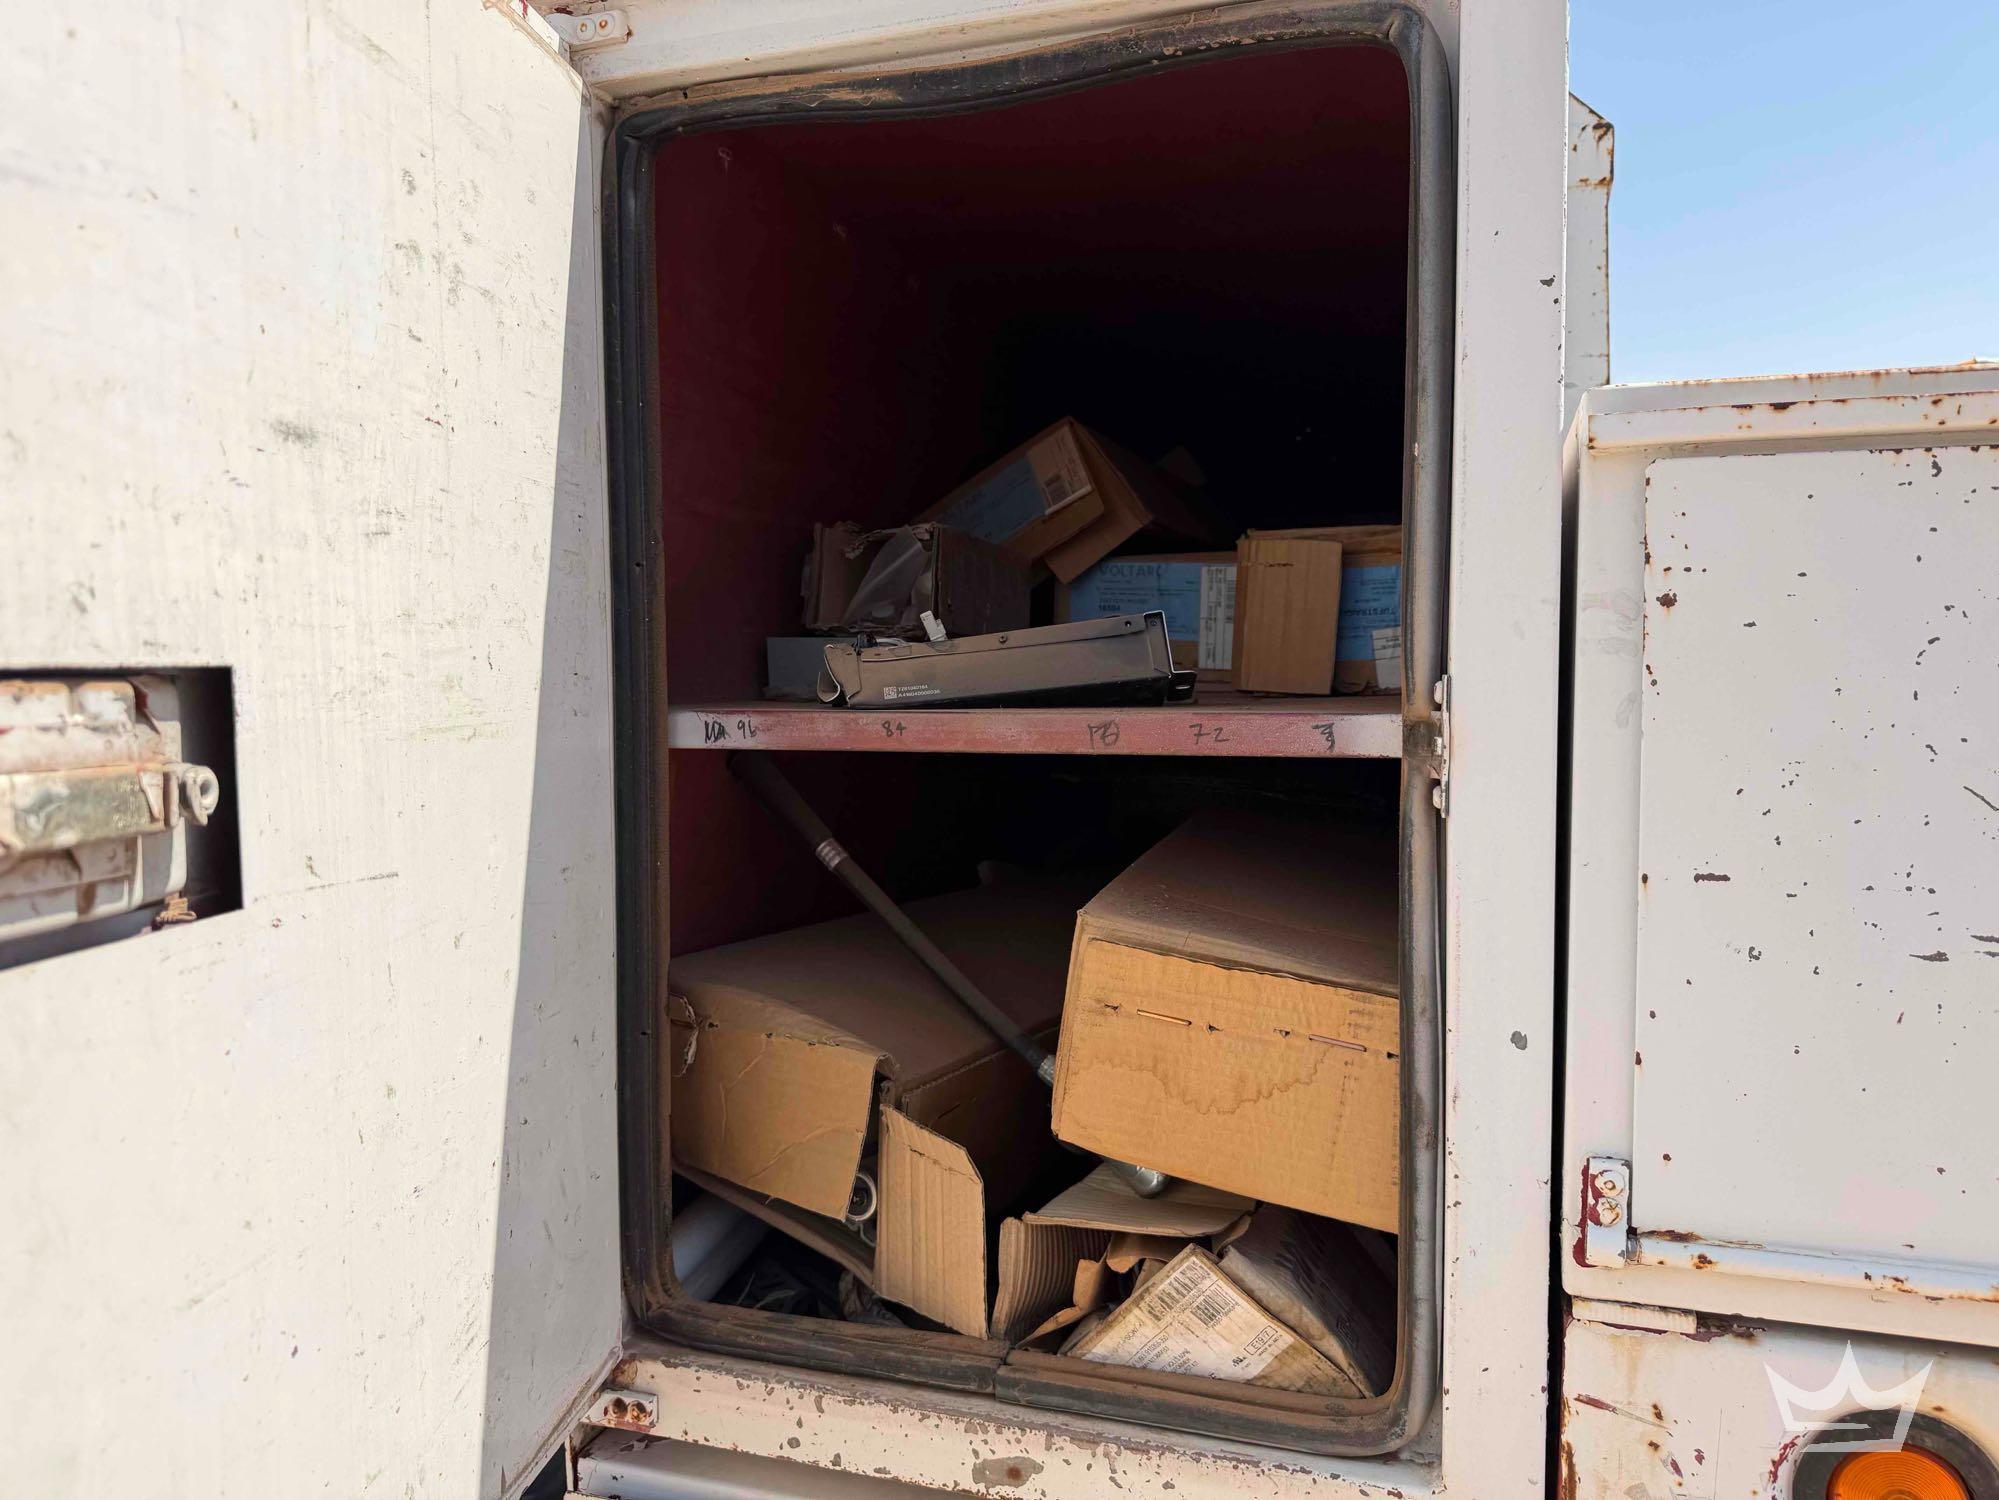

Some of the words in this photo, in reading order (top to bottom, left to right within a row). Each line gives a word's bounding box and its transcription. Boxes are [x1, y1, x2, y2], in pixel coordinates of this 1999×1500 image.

[737, 720, 758, 739] 96
[882, 720, 907, 737] 84
[1189, 723, 1230, 745] 72
